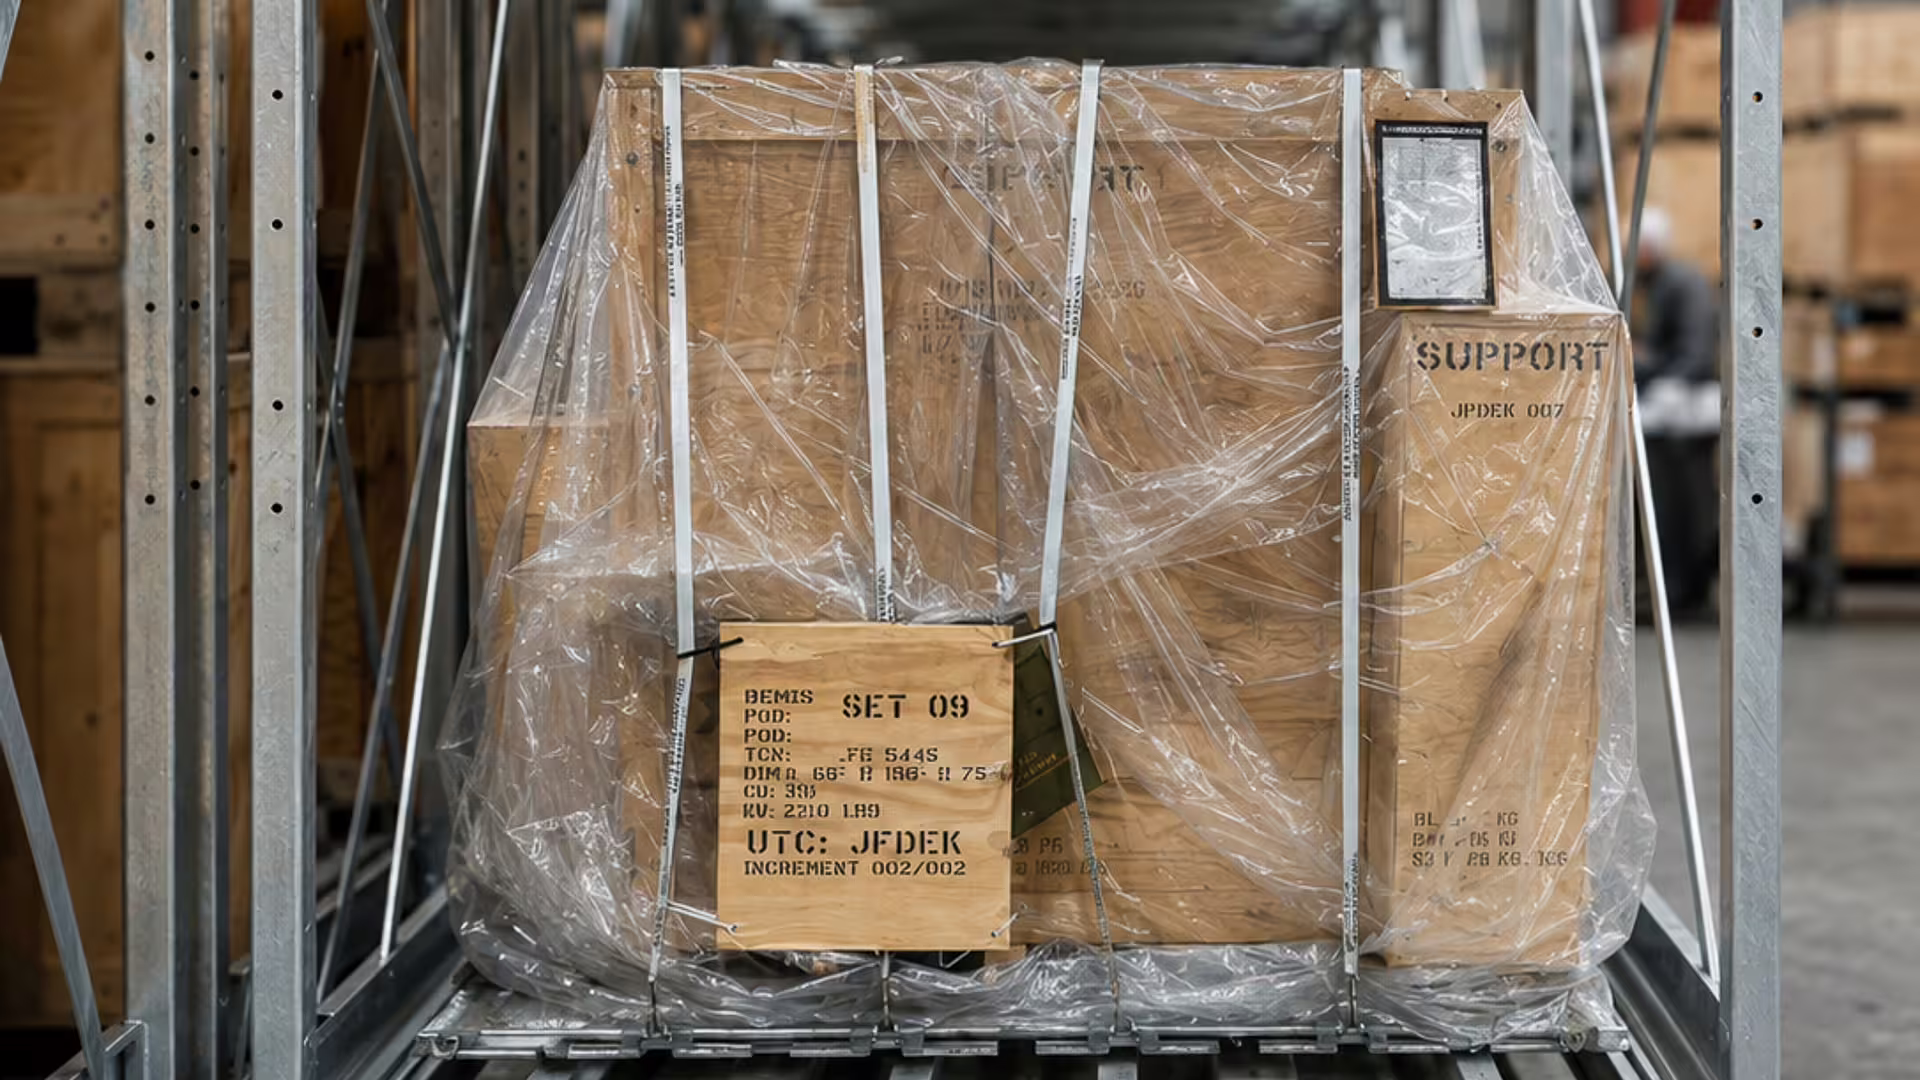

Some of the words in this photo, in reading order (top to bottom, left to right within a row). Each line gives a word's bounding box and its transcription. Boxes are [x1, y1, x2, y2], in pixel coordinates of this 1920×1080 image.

[1416, 341, 1609, 372] SUPPORT
[1451, 403, 1515, 419] JPDEK
[744, 689, 814, 704] BEMIS
[842, 694, 906, 718] SET
[929, 694, 969, 718] 09
[744, 709, 791, 723] POD:
[744, 728, 791, 743] POD:
[744, 747, 791, 762] TCN:
[747, 830, 827, 854] UTC:
[850, 830, 960, 854] JFDEK
[744, 860, 859, 875] INCREMENT
[872, 860, 966, 875] 002/002
